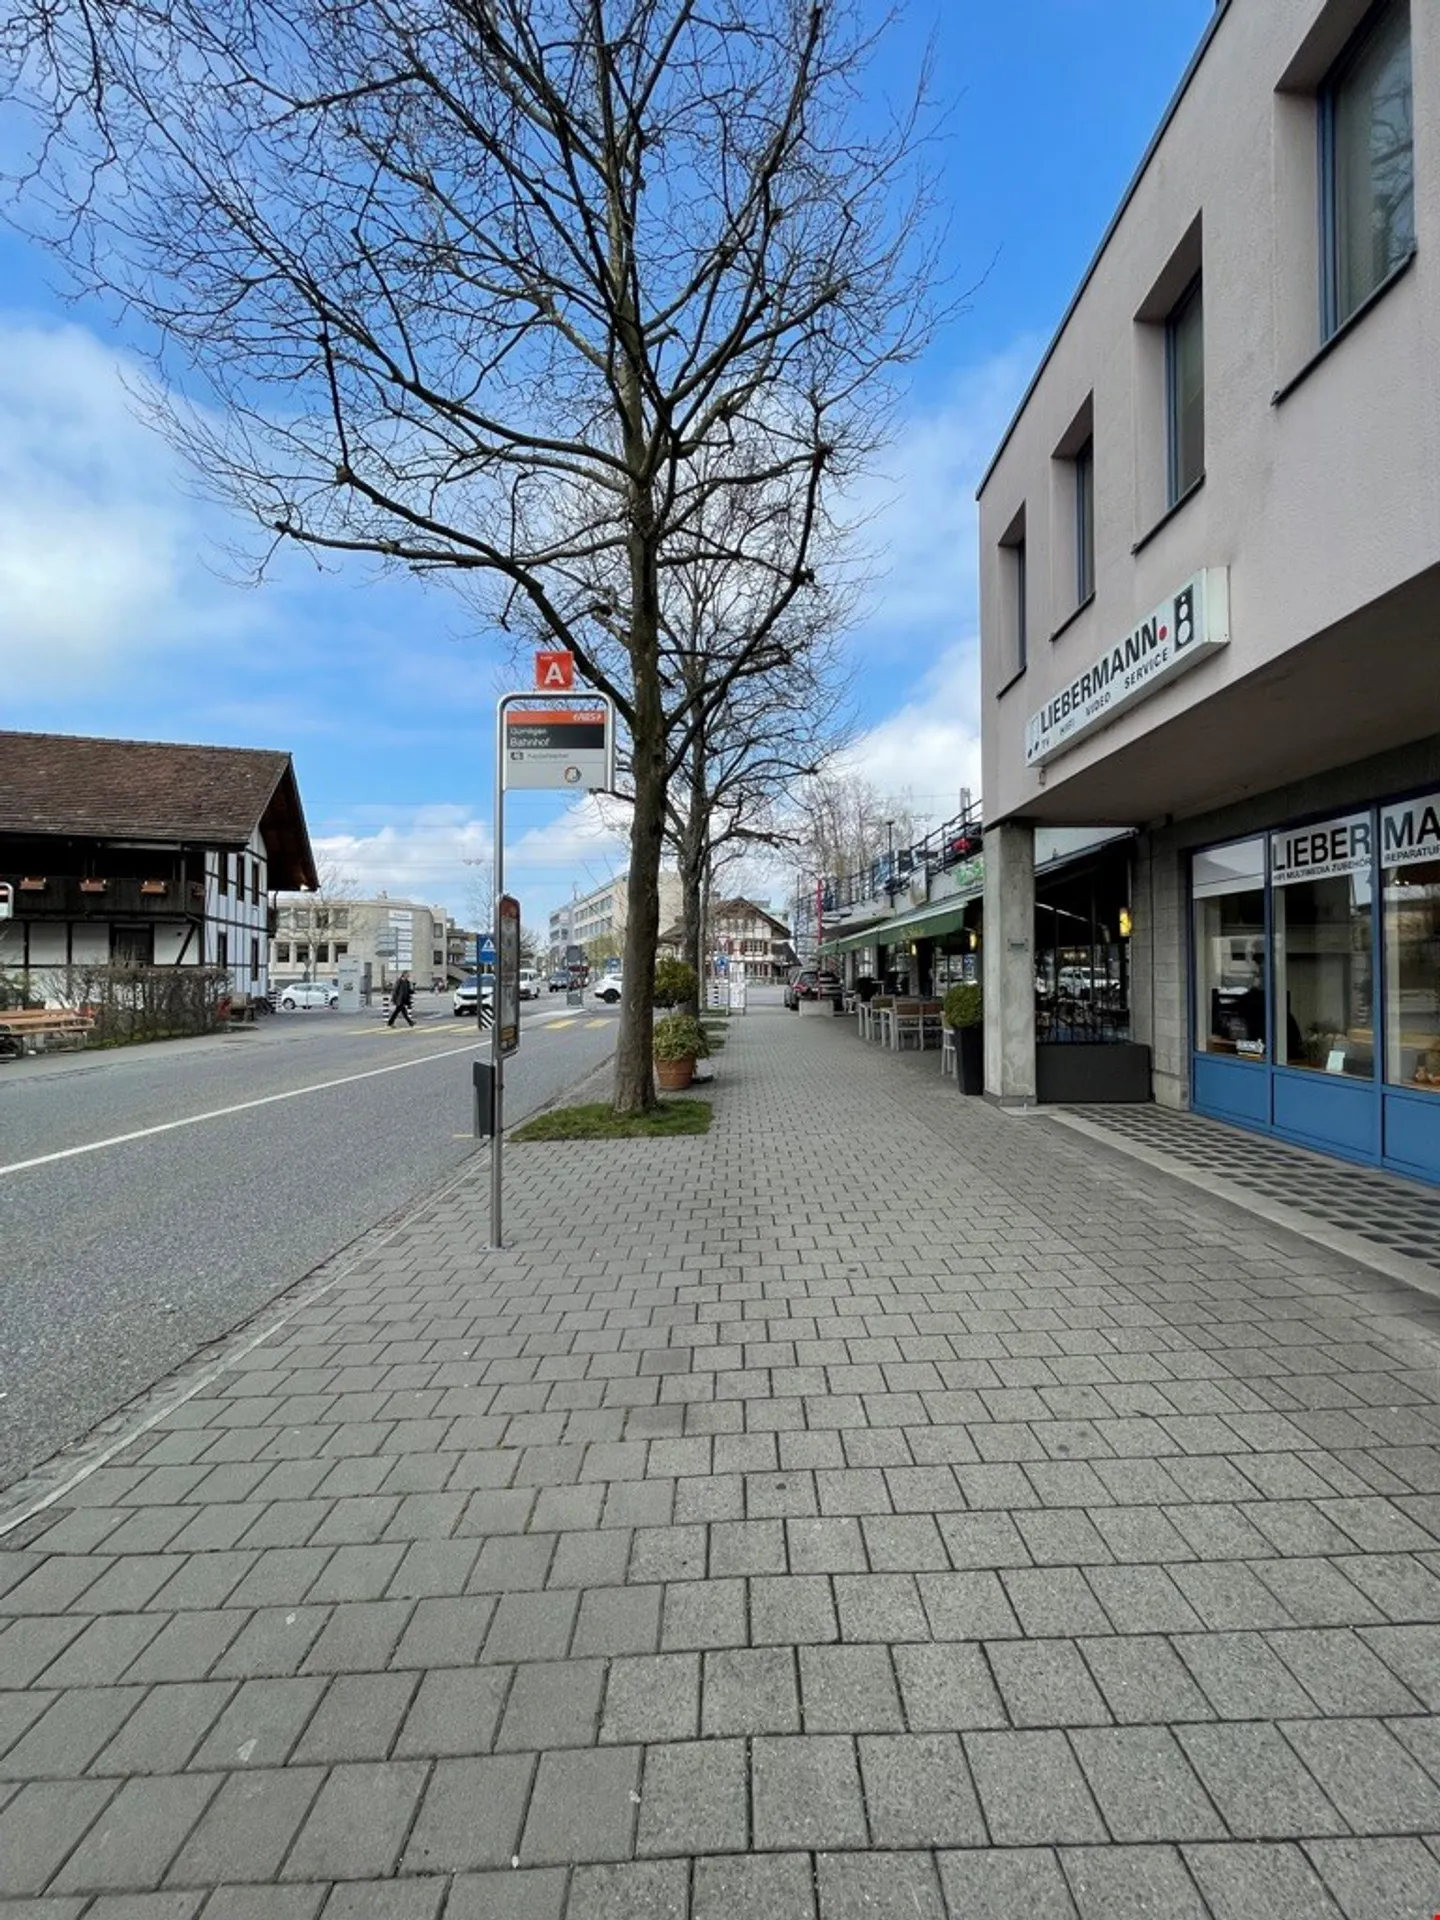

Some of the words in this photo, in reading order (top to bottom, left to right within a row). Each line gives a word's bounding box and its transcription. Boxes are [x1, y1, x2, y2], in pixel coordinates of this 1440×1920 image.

[544, 661, 565, 685] A
[1085, 691, 1111, 716] VIDEO
[1124, 646, 1169, 690] SERVICE
[509, 737, 551, 748] Bahnhof
[1287, 865, 1330, 879] MULTIMEDIA
